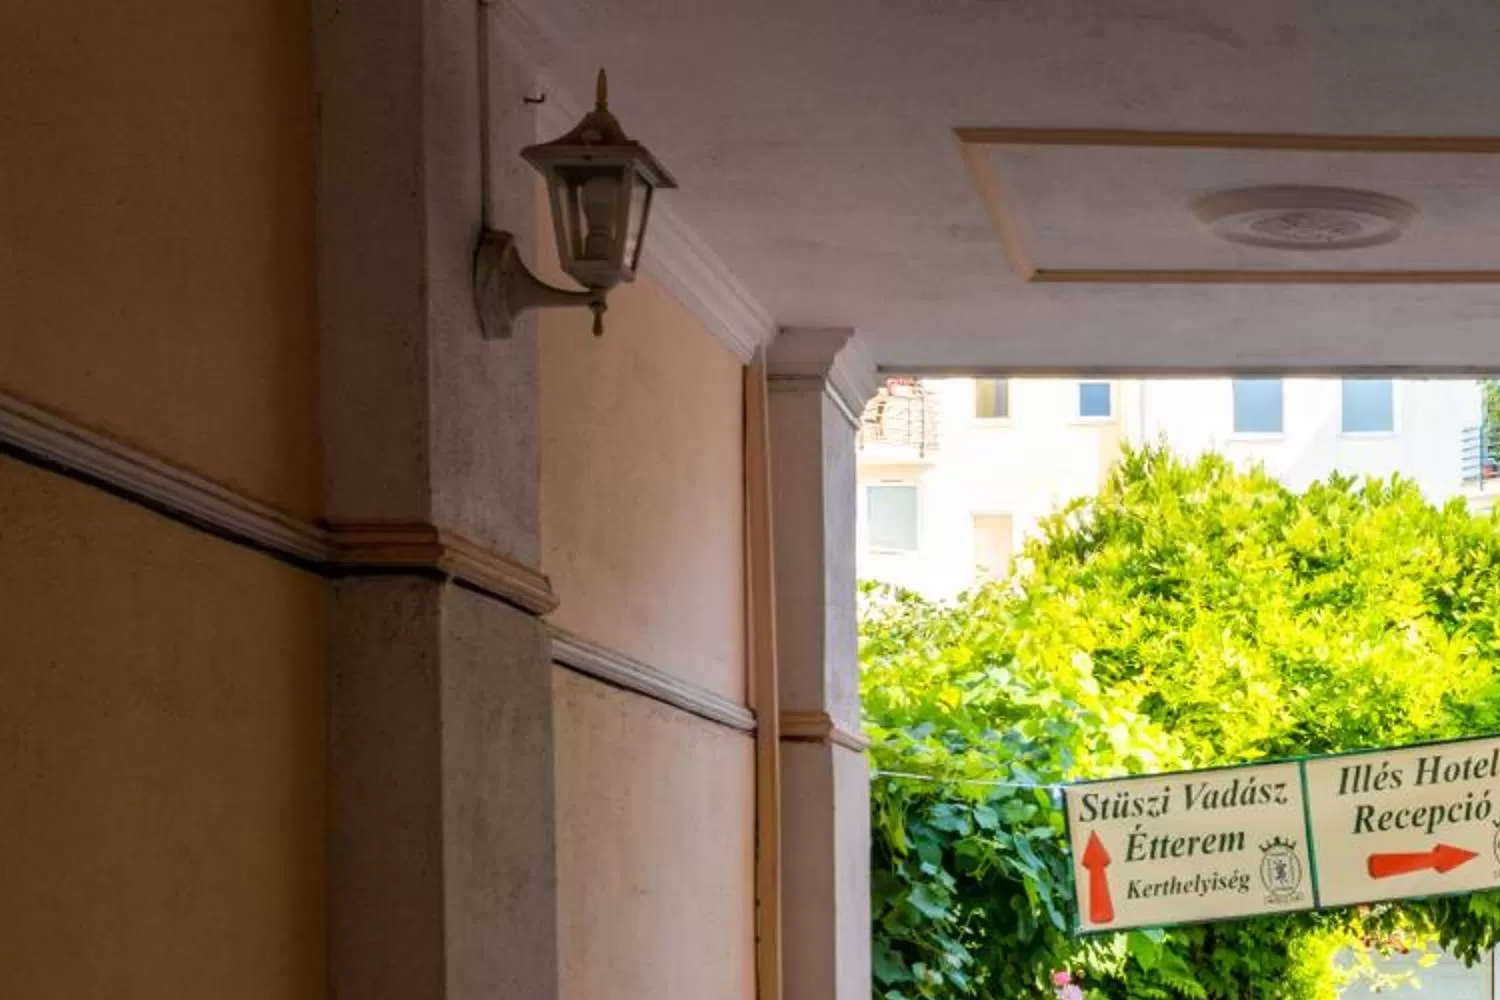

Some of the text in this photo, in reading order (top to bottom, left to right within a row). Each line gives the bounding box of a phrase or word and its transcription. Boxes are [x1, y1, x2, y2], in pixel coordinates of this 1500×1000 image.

[1337, 748, 1500, 796] Illés Hotel
[1079, 776, 1289, 823] Stüszi Vadász
[1352, 789, 1492, 835] Recepció
[1124, 824, 1245, 863] Étterem
[1127, 869, 1251, 900] Kerthelyiség
